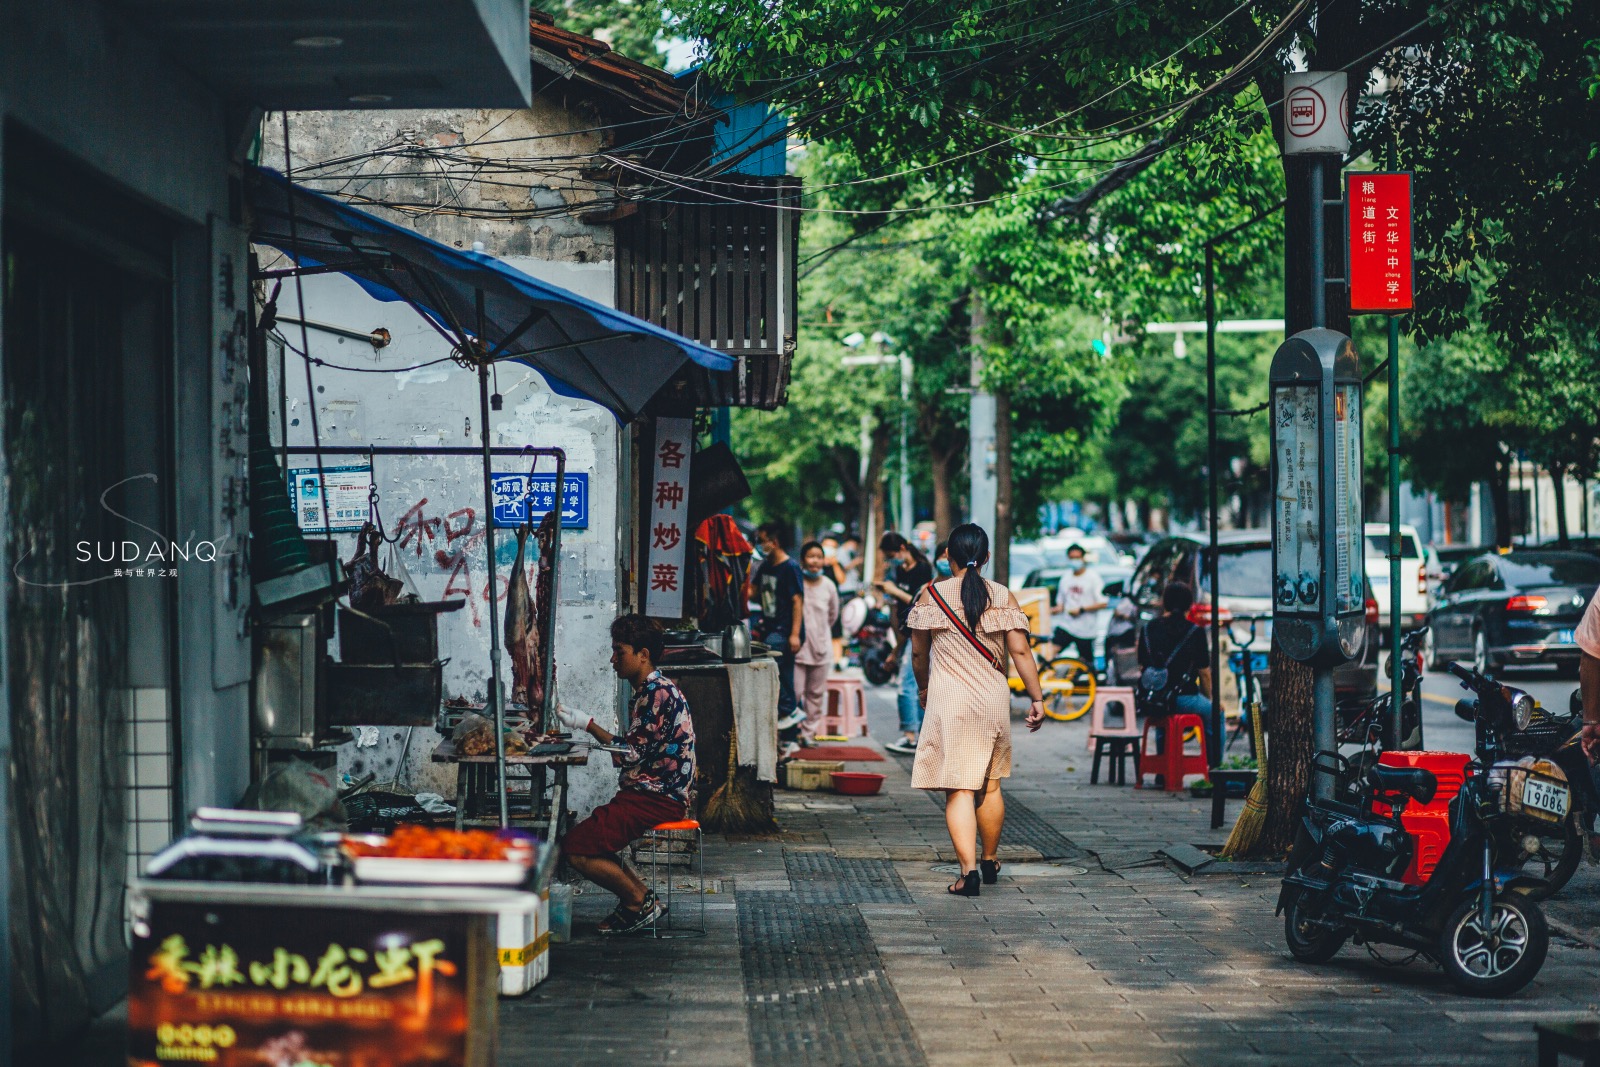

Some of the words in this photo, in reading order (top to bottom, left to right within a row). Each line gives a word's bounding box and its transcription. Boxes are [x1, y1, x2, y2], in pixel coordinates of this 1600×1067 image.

[1362, 181, 1377, 244] 粮道街
[1386, 206, 1399, 295] 文华中学
[502, 482, 579, 493] 防震灾疏散方向
[532, 495, 579, 507] 文华学
[651, 439, 686, 592] 各种炒菜
[1527, 790, 1562, 812] 19086
